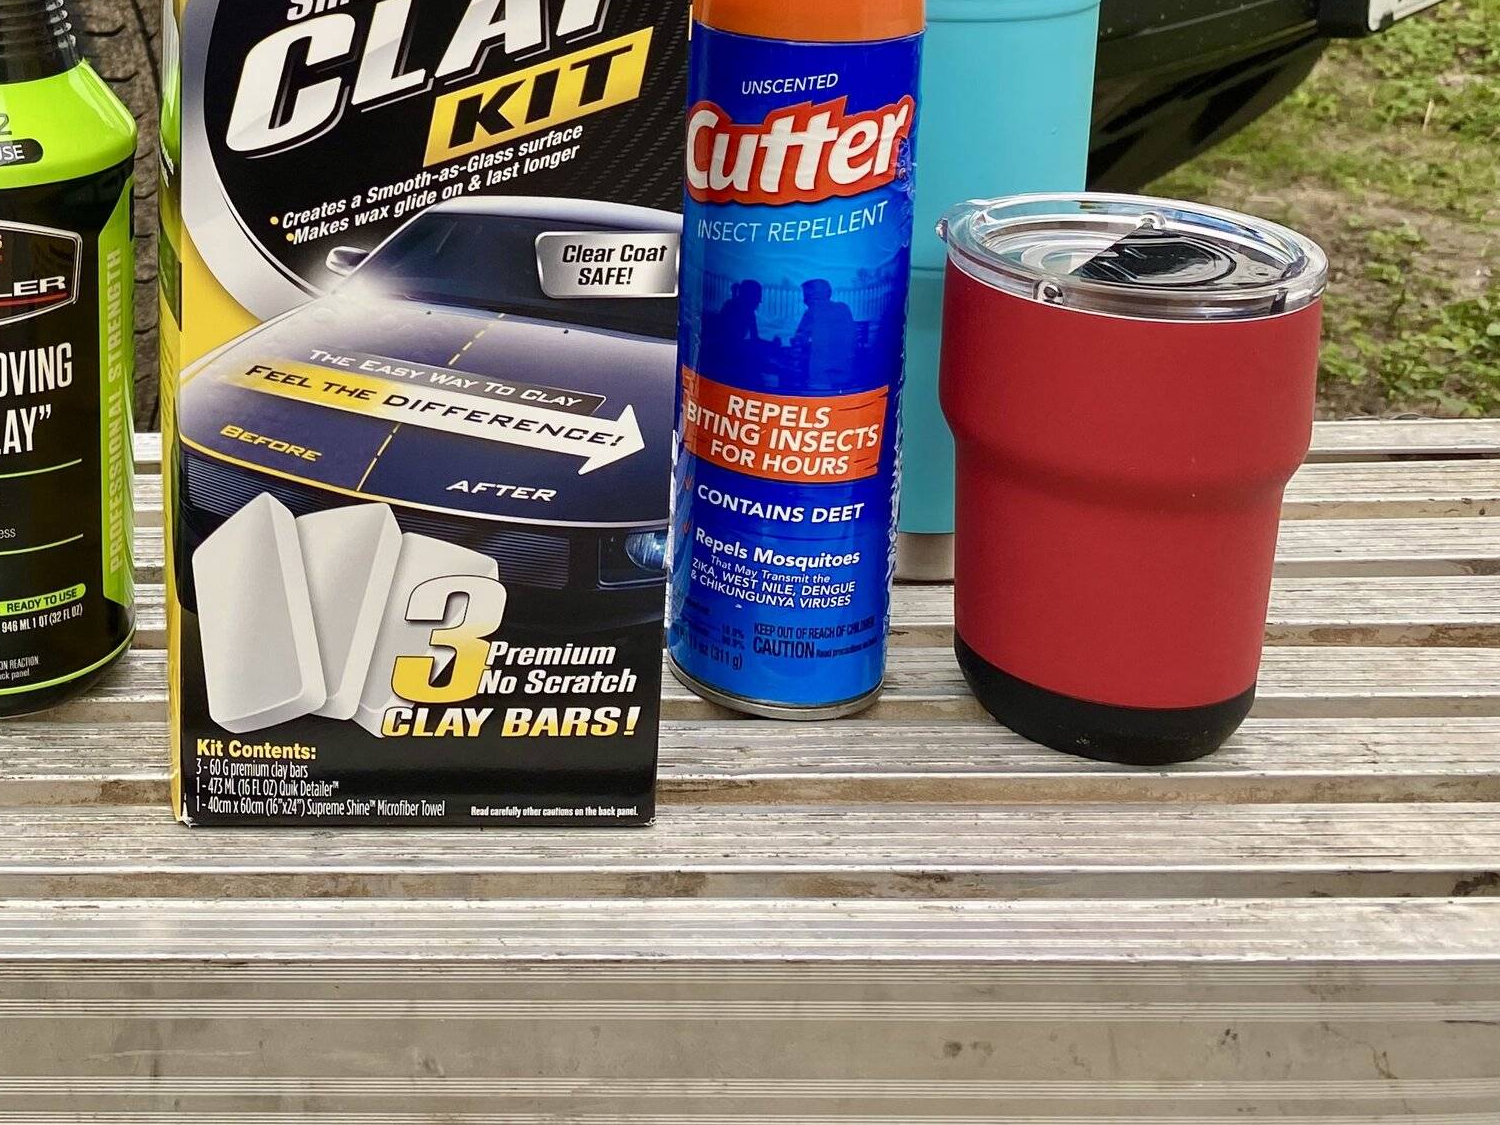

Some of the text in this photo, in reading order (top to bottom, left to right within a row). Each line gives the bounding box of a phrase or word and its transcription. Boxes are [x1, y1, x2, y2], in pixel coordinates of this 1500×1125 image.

[449, 43, 634, 149] KIT
[742, 73, 838, 94] UNSCENTED
[686, 104, 908, 193] Cutter
[283, 126, 583, 229] Creates a Smooth-as-Glass surface
[292, 144, 580, 245] Makes wax glide on & last longer
[698, 201, 888, 242] INSECT REPELLENT
[562, 243, 667, 265] Clear Coat
[578, 267, 633, 286] SAFE!
[309, 350, 583, 409] THE EASY WAY TO CLAY
[107, 250, 123, 573] PROFESSIONAL STRENGTH
[245, 364, 625, 447] FEEL THE DIFFERENCE!
[727, 395, 831, 428] REPELS
[220, 424, 322, 462] BEFORE
[686, 400, 879, 453] BITING INSECTS
[711, 441, 849, 475] FOR HOURS
[445, 480, 558, 503] AFTER
[697, 485, 865, 524] CONTAINS DEET
[696, 528, 860, 571] Repels Mosquitoes
[692, 558, 856, 596] ZIKA, WEST NILE, DENGUE
[711, 554, 830, 583] That May Transmit the
[7, 589, 77, 613] READY TO USE
[700, 576, 851, 608] CHIKUNGUNYA VIRUSES
[392, 575, 508, 704] 3
[486, 642, 616, 665] Premium
[753, 636, 815, 658] CAUTION
[479, 669, 637, 694] No Scratch
[382, 706, 641, 738] CLAY BARS!
[197, 739, 317, 759] Kit Contents:
[230, 761, 308, 778] premium clay bars
[280, 780, 298, 797] Quik
[307, 799, 445, 817] Supreme Microfiber Towel
